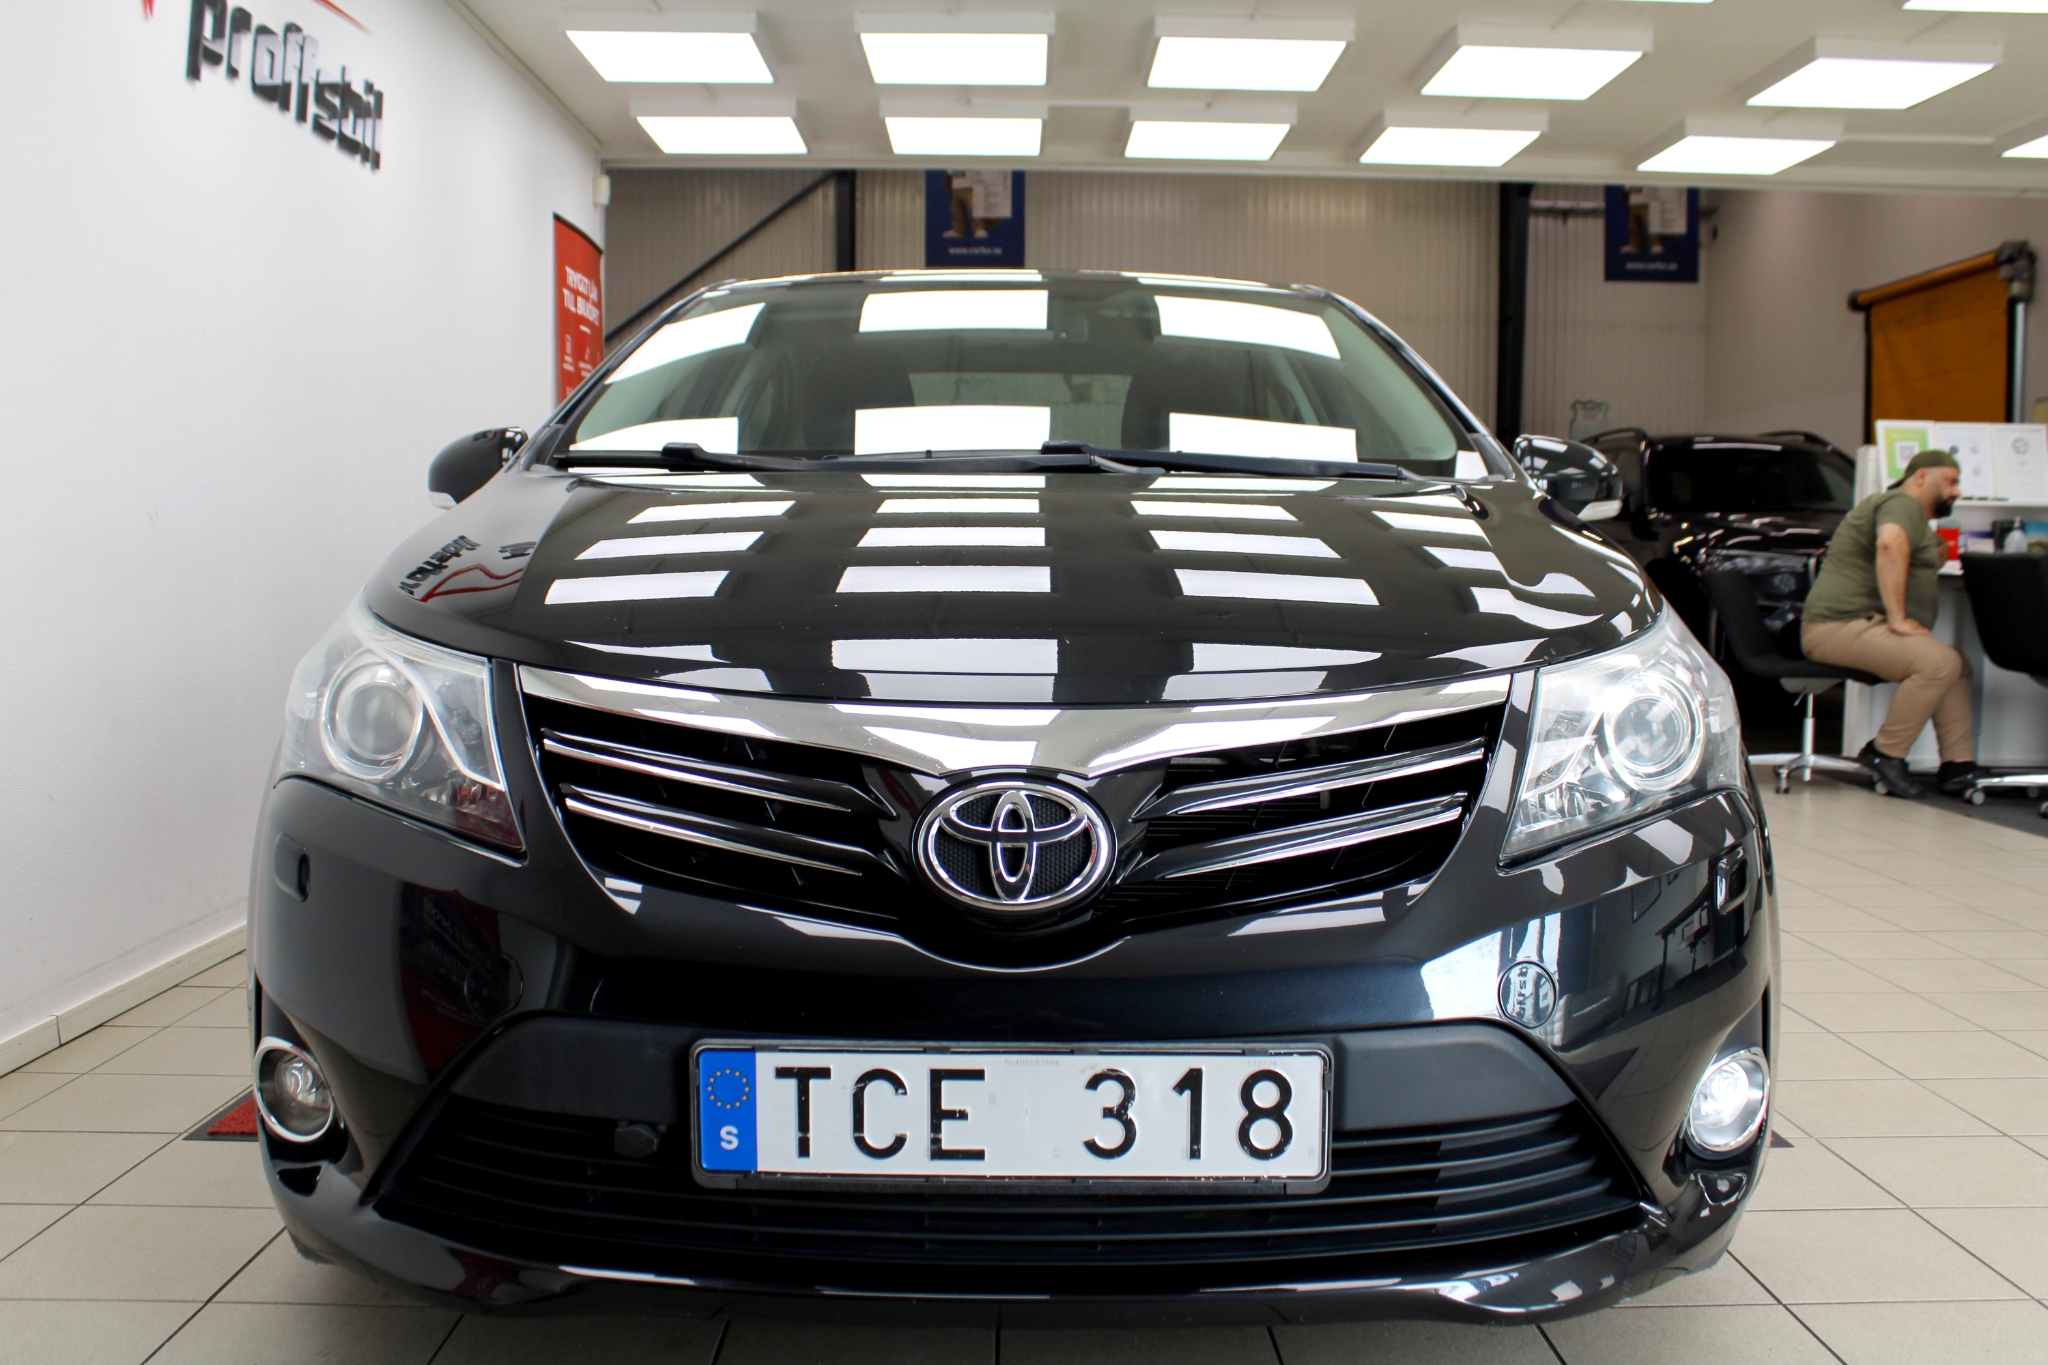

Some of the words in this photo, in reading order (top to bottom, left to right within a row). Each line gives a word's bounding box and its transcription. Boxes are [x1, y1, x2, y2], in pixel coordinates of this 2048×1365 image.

[562, 288, 576, 312] TILL
[774, 1066, 986, 1161] TCE
[1083, 1067, 1294, 1162] 318
[720, 1125, 739, 1151] S
